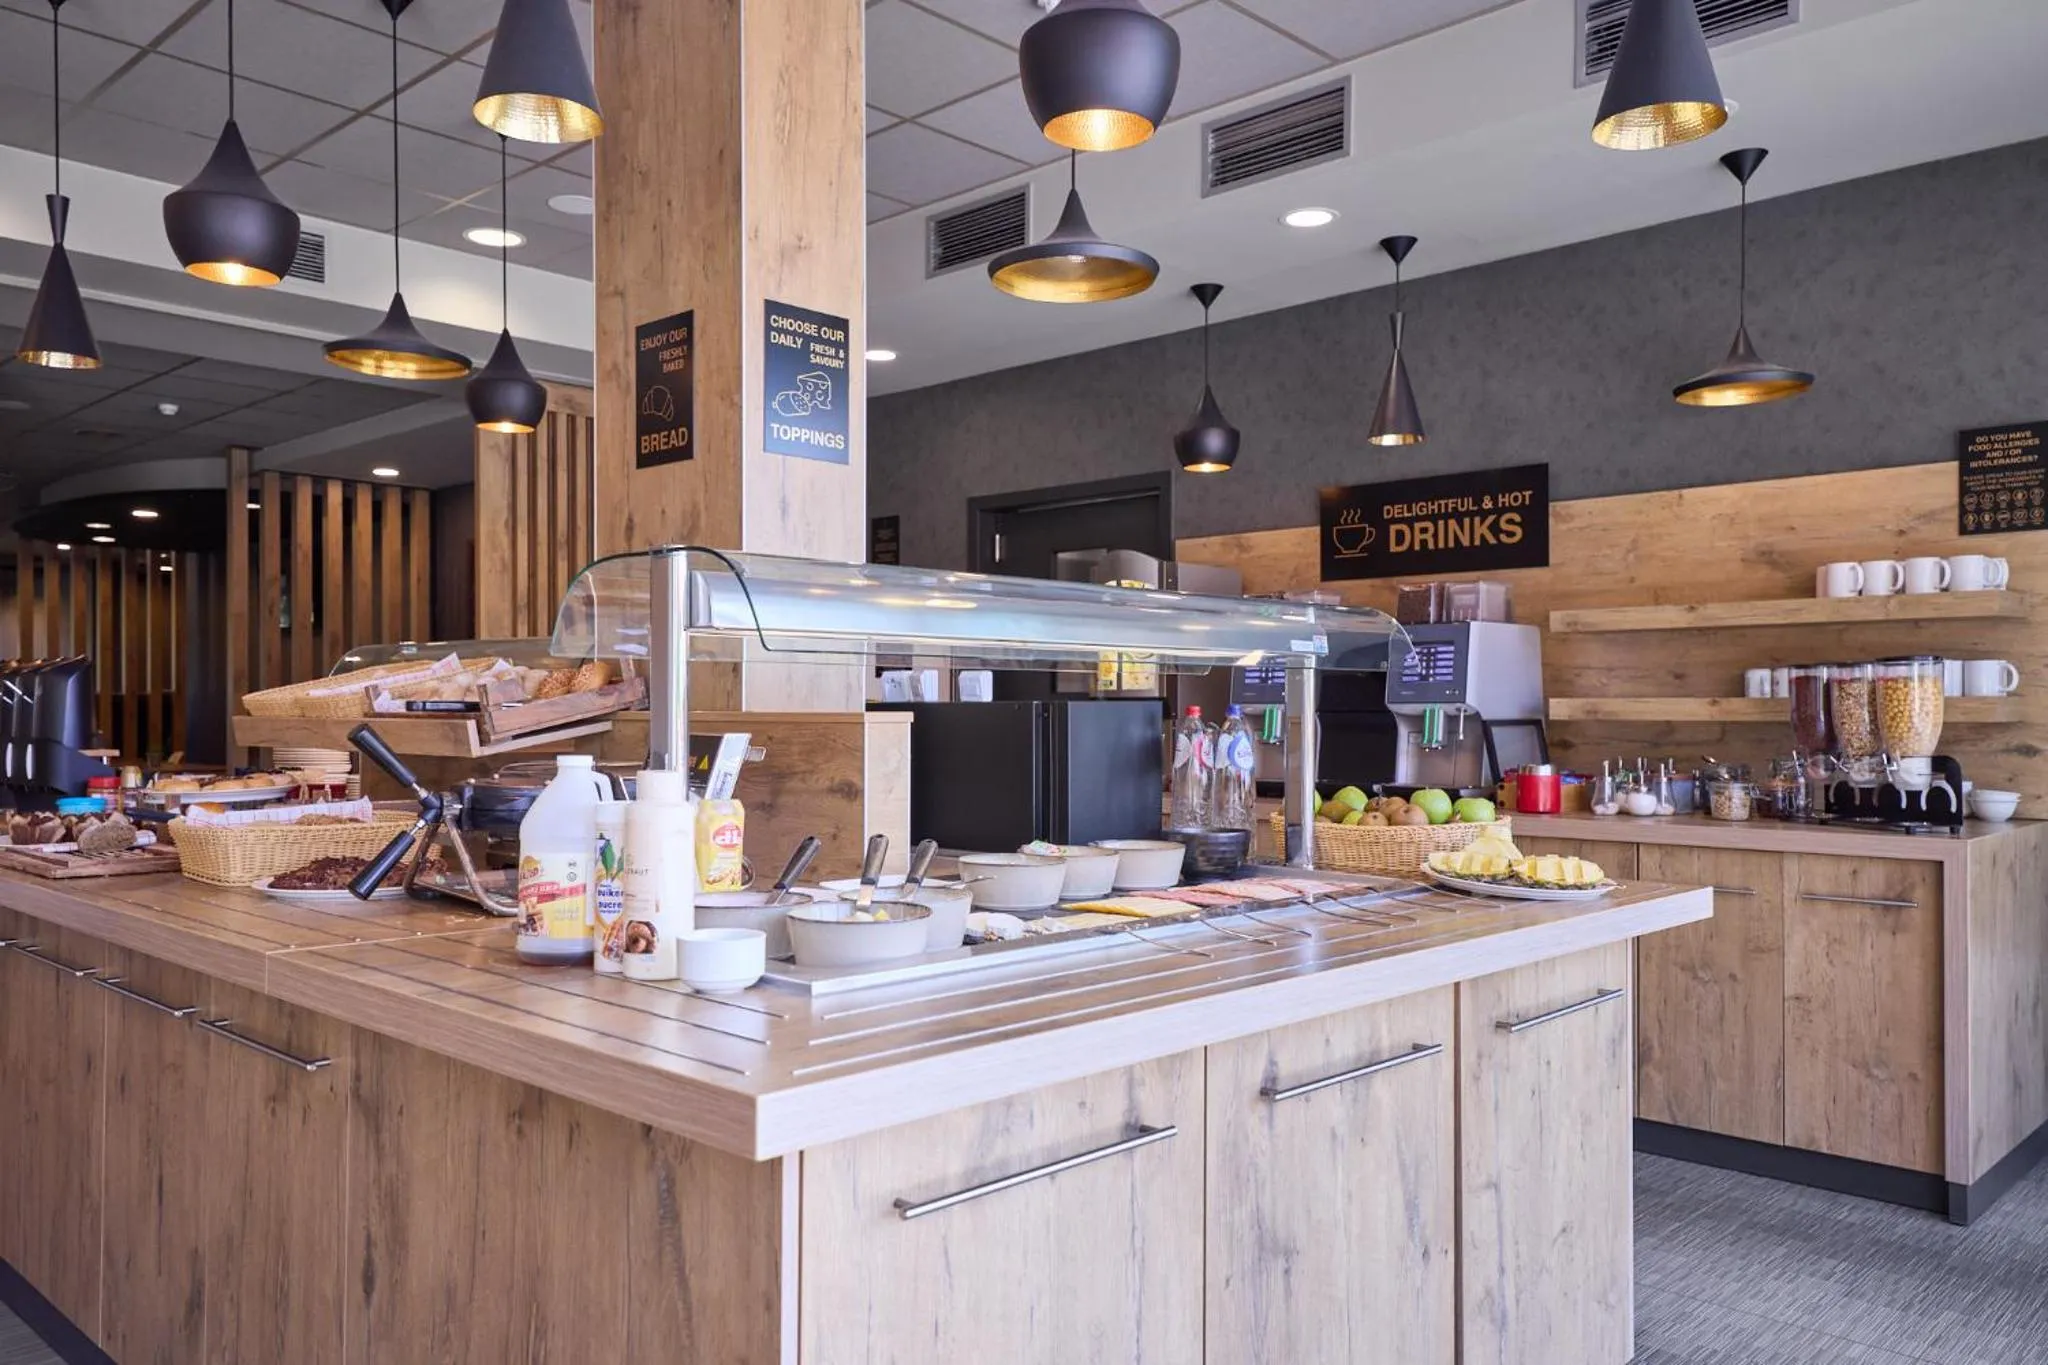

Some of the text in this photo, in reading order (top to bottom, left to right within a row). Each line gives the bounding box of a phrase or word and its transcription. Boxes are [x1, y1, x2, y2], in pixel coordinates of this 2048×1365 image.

[770, 315, 845, 342] CHOOSE OUR
[640, 327, 688, 351] ENJOY OUR
[770, 332, 804, 349] DAILY
[809, 343, 845, 359] FRESH &
[809, 353, 845, 369] SAVOURY
[640, 427, 689, 454] BREAD
[770, 423, 845, 449] TOPPINGS
[1975, 430, 2032, 443] DO YOU HAVE
[1968, 444, 1992, 452] FOOD
[1986, 450, 2003, 458] AND
[1383, 490, 1534, 520] DELIGHTFUL & HOT
[1389, 512, 1524, 553] DRINKS
